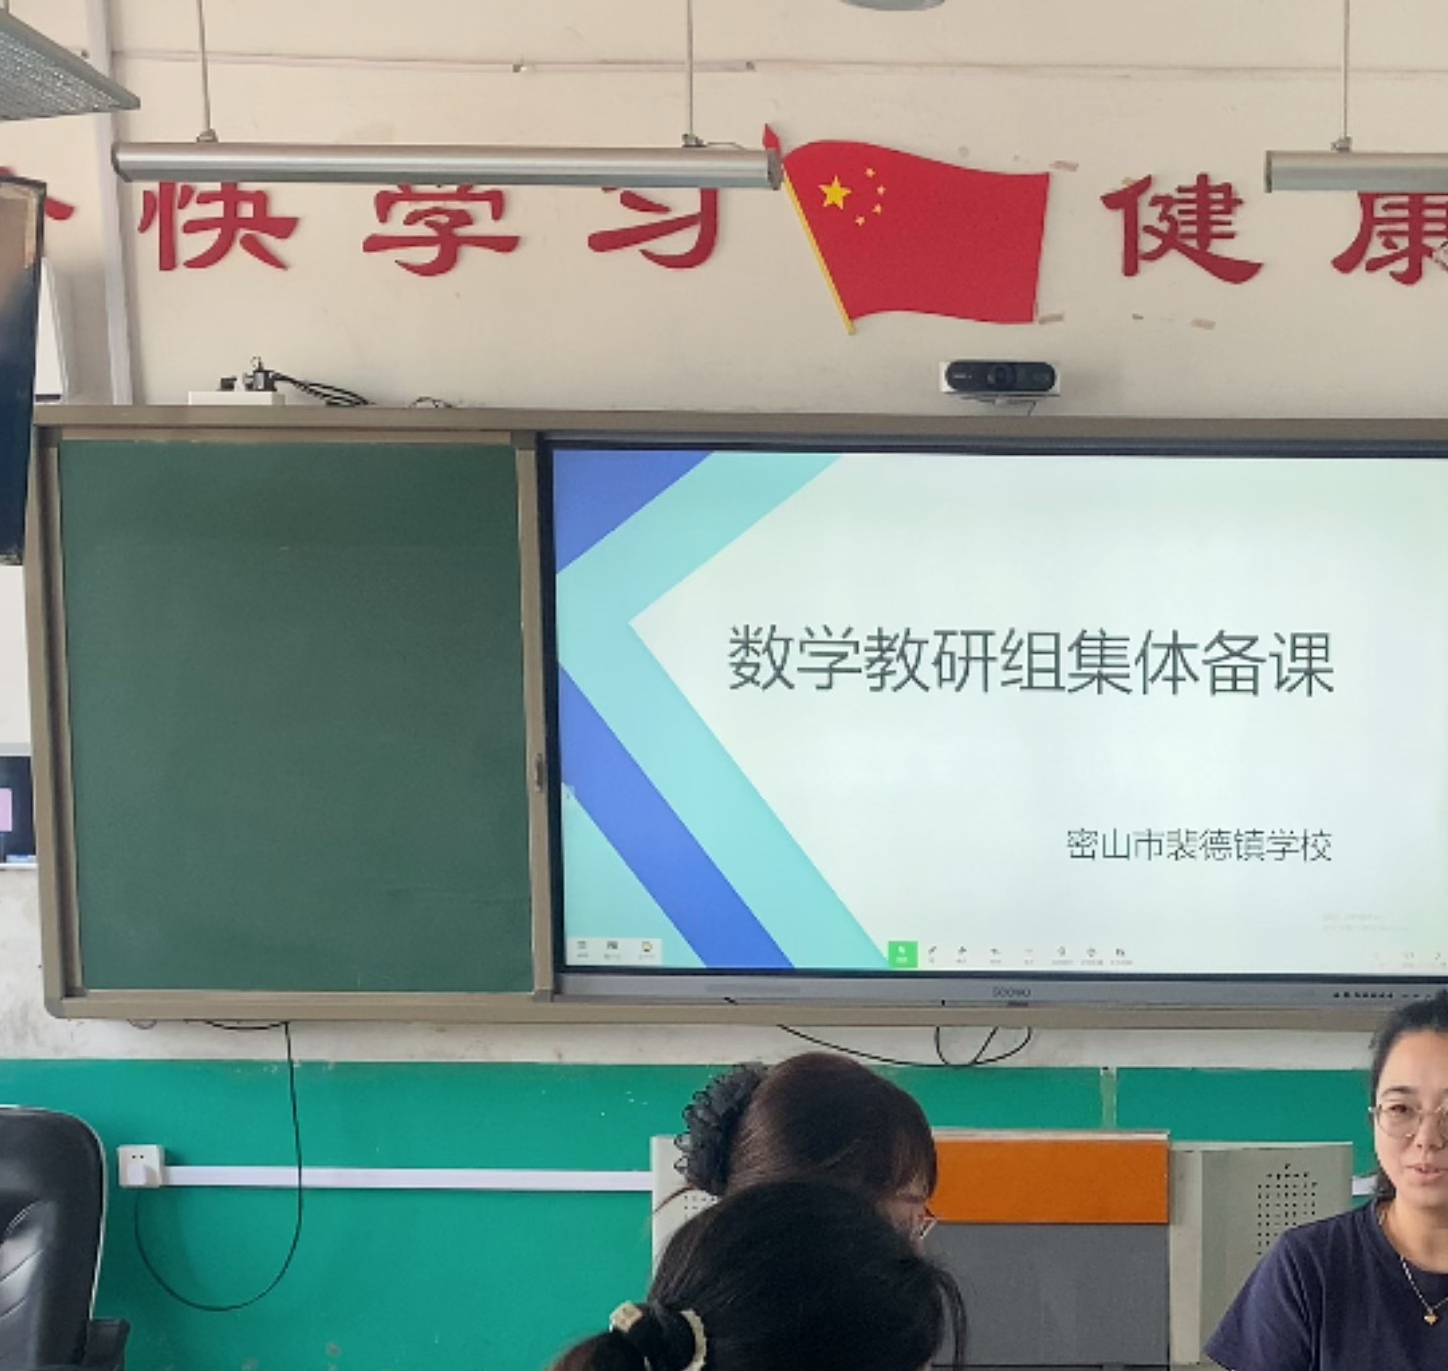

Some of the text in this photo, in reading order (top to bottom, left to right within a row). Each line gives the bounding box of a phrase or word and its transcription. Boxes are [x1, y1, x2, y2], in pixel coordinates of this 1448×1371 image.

[0, 166, 720, 277] 快学习
[728, 624, 1334, 697] 数学教研组集体备课
[1067, 828, 1333, 862] 密山市裴德镇学校
